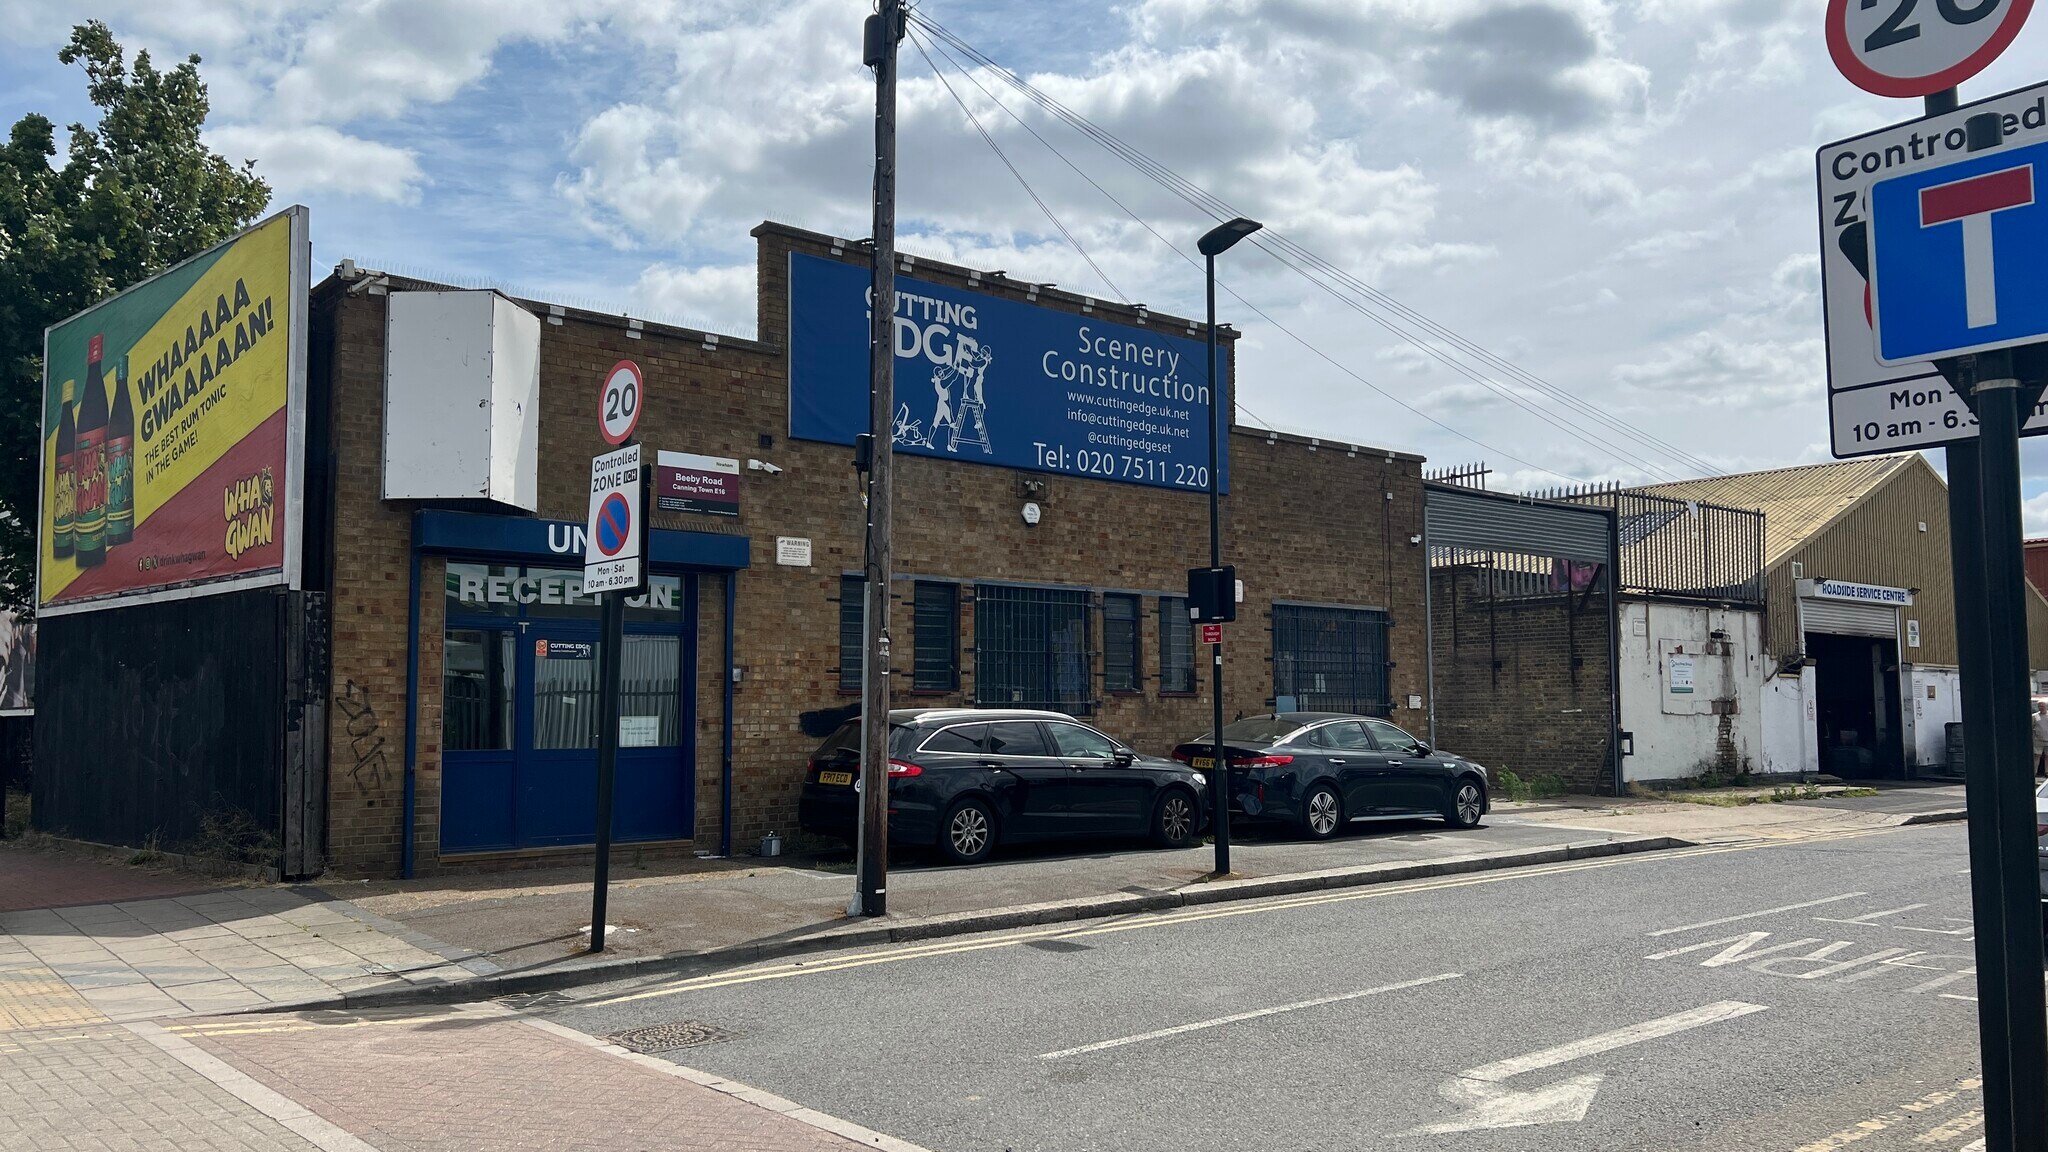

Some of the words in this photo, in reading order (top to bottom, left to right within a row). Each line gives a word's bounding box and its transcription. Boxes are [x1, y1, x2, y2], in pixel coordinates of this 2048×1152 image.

[1832, 96, 2046, 181] Controed
[137, 277, 251, 406] WHAAAAA
[866, 310, 979, 379] DGE
[1078, 326, 1180, 377] Scenery
[141, 296, 274, 442] GWAAAAAN!
[1042, 350, 1210, 406] Construction
[606, 383, 637, 422] 20
[1067, 391, 1190, 421] www.cuttingedge.uk.net
[1890, 389, 1942, 410] Mon
[144, 444, 159, 466] THE
[161, 425, 180, 450] BEST
[181, 407, 199, 435] RUM
[200, 384, 227, 416] TONIC
[1067, 408, 1190, 439] info@cuttingedge.uk.net
[1853, 421, 1880, 443] 10
[1886, 419, 1922, 438] am
[146, 468, 154, 485] IN
[155, 455, 171, 476] THE
[171, 429, 199, 462] GAME!
[1087, 431, 1172, 454] @cuttingedgeset
[594, 449, 638, 473] Controlled
[1033, 441, 1071, 470] Tel:
[1077, 449, 1115, 475] 020
[1121, 455, 1166, 482] 7511
[1175, 463, 1218, 488] 220
[593, 471, 622, 493] ZONE
[672, 483, 697, 493] Canning
[698, 486, 714, 494] Town
[675, 472, 700, 485] Beeby
[702, 476, 723, 486] Road
[224, 473, 261, 522] WHA
[225, 503, 274, 561] GWAN
[588, 580, 595, 588] 10
[608, 575, 622, 585] 6.30
[623, 575, 634, 585] pm
[597, 567, 610, 576] Mon
[614, 564, 625, 573] Sat
[459, 575, 672, 609] RECEPN
[1822, 583, 1856, 597] ROADSIDE
[1856, 587, 1882, 600] SERVICE
[1882, 590, 1905, 602] CENTRE
